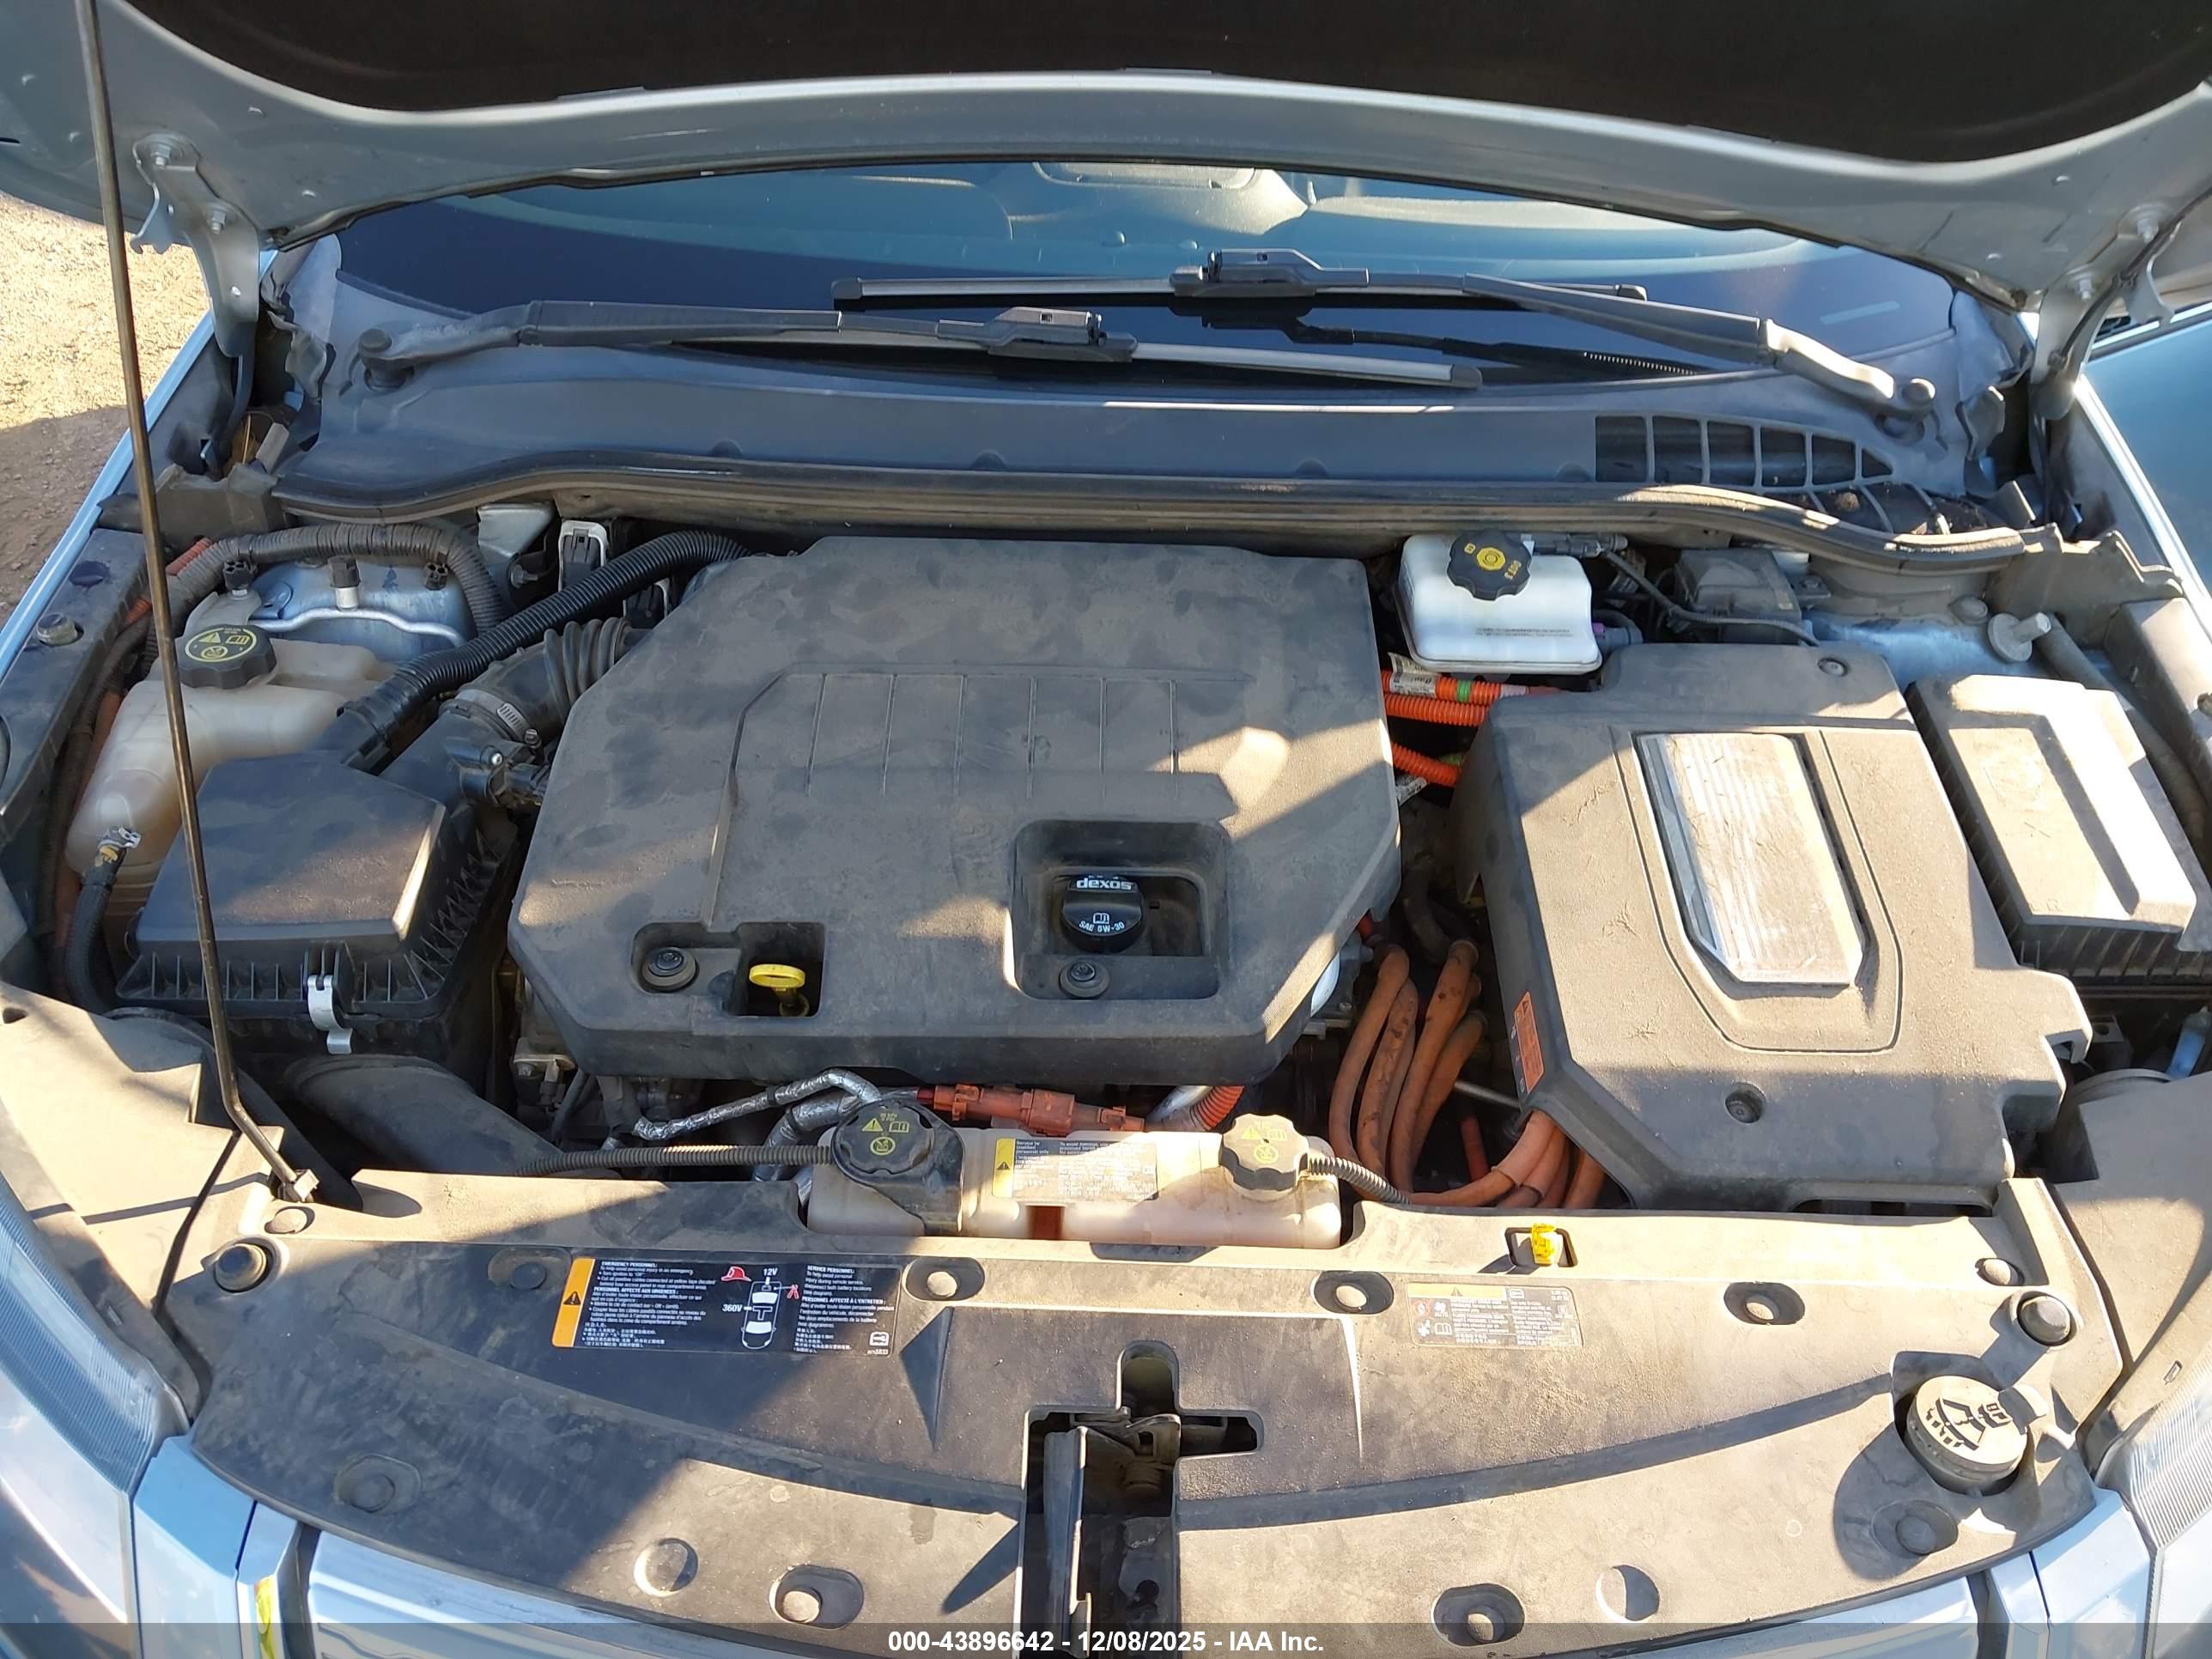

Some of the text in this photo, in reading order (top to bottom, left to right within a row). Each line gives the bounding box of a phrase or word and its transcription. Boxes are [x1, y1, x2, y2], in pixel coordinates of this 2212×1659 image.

[1077, 877, 1133, 890] dexos
[1079, 921, 1125, 933] SAE 5W-30
[763, 1267, 778, 1276] 12V
[722, 1304, 743, 1312] 360V
